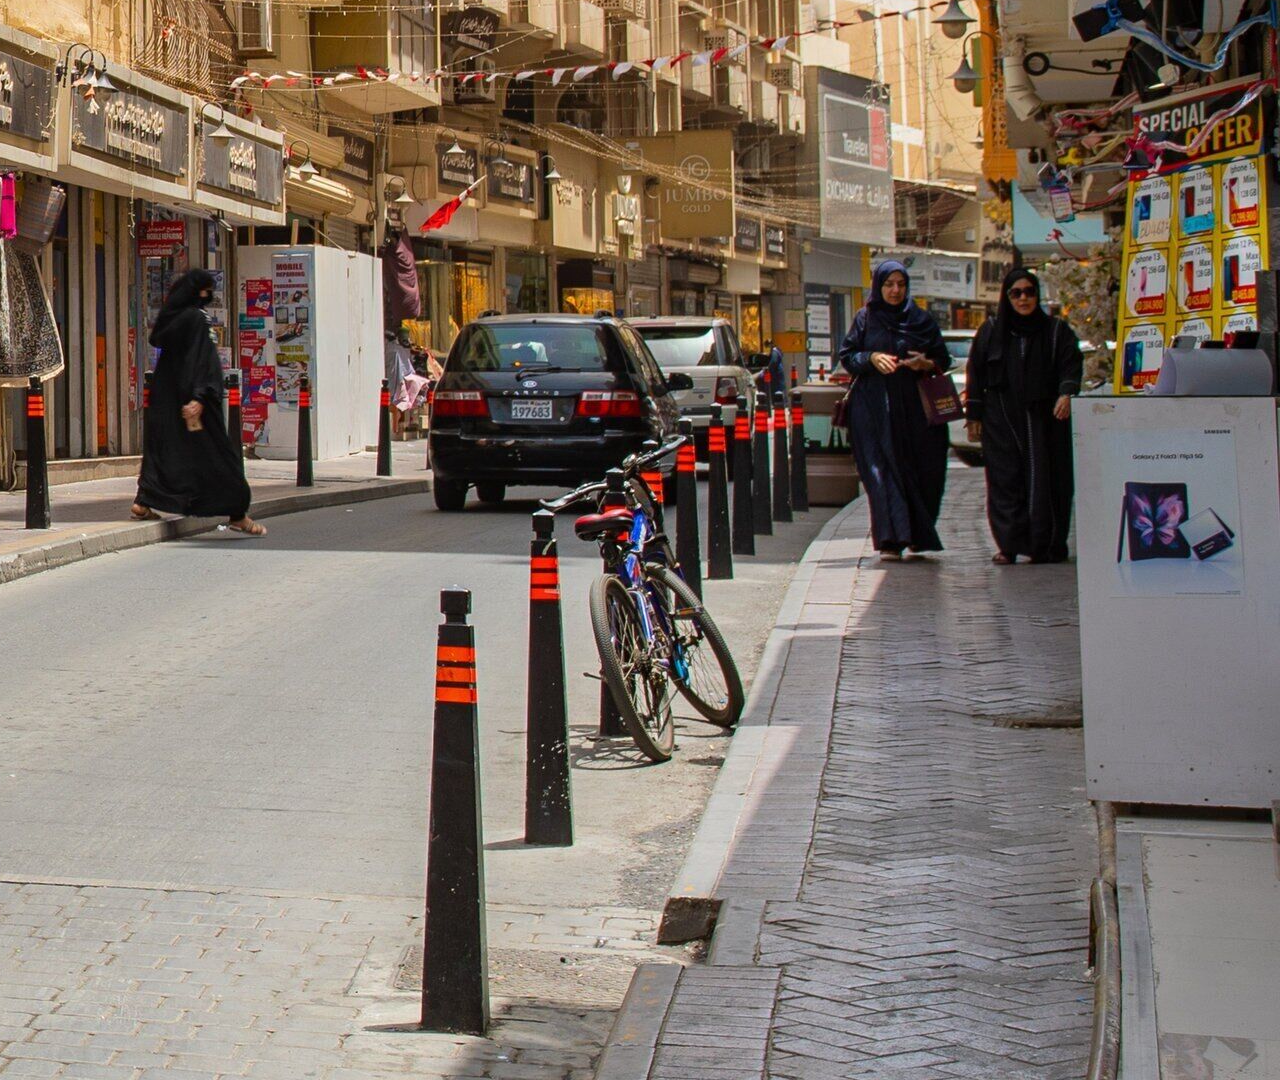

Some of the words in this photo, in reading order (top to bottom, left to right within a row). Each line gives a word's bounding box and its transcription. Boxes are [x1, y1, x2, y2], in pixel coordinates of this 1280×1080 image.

[1140, 101, 1209, 132] SPECIAL
[1185, 114, 1252, 157] OFFER
[842, 132, 868, 157] Travelex
[665, 187, 728, 204] JUMBO
[826, 178, 864, 202] EXCHANGE
[681, 204, 711, 213] GOLD
[275, 263, 303, 271] MOBILE
[512, 406, 551, 418] 197683
